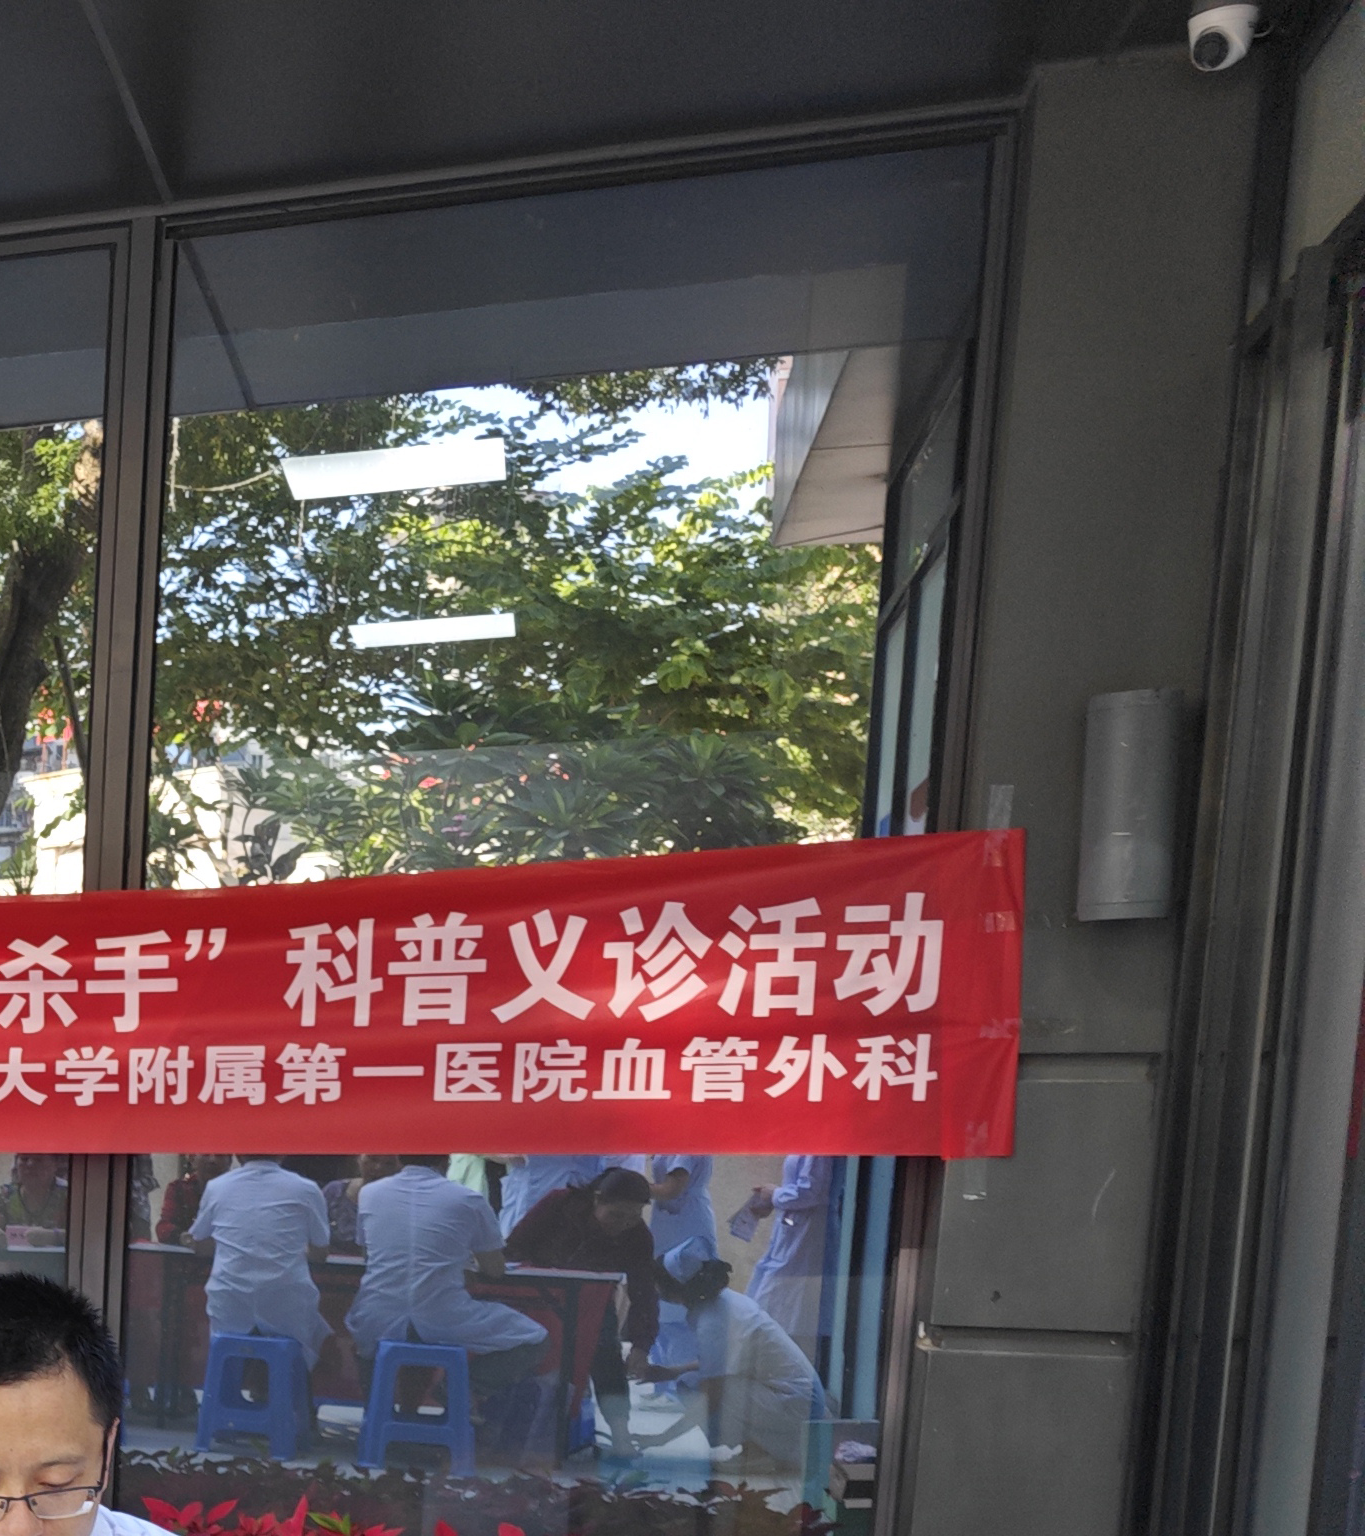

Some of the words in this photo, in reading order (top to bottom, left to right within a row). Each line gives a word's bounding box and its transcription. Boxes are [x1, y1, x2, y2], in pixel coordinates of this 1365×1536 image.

[283, 892, 944, 1028] 科普义诊活动
